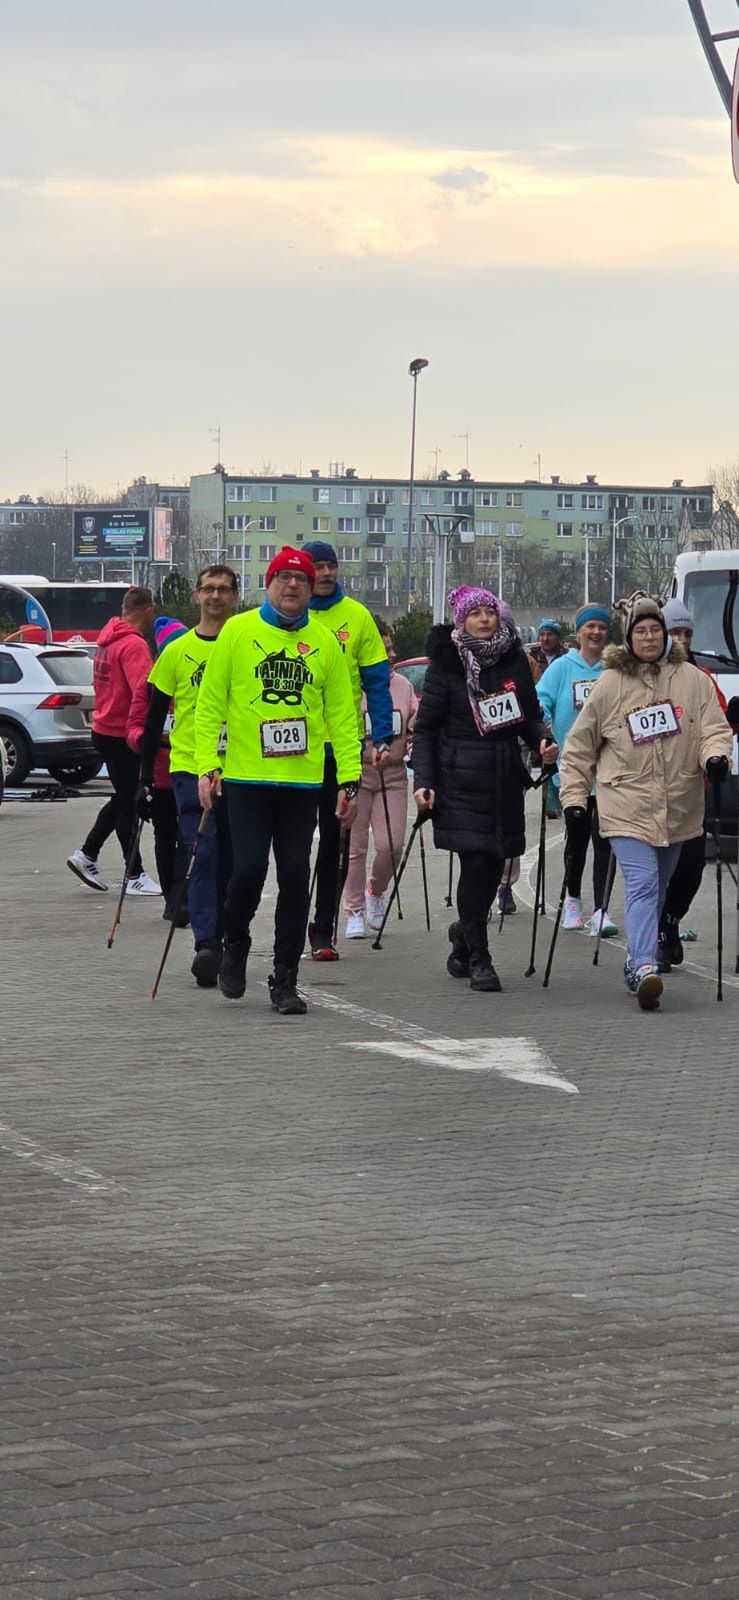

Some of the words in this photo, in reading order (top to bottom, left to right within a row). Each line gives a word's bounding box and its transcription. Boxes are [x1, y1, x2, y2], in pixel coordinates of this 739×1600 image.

[254, 660, 313, 685] TAJNIAKI
[489, 699, 513, 718] 074
[640, 711, 667, 730] 073
[273, 728, 300, 744] 028
